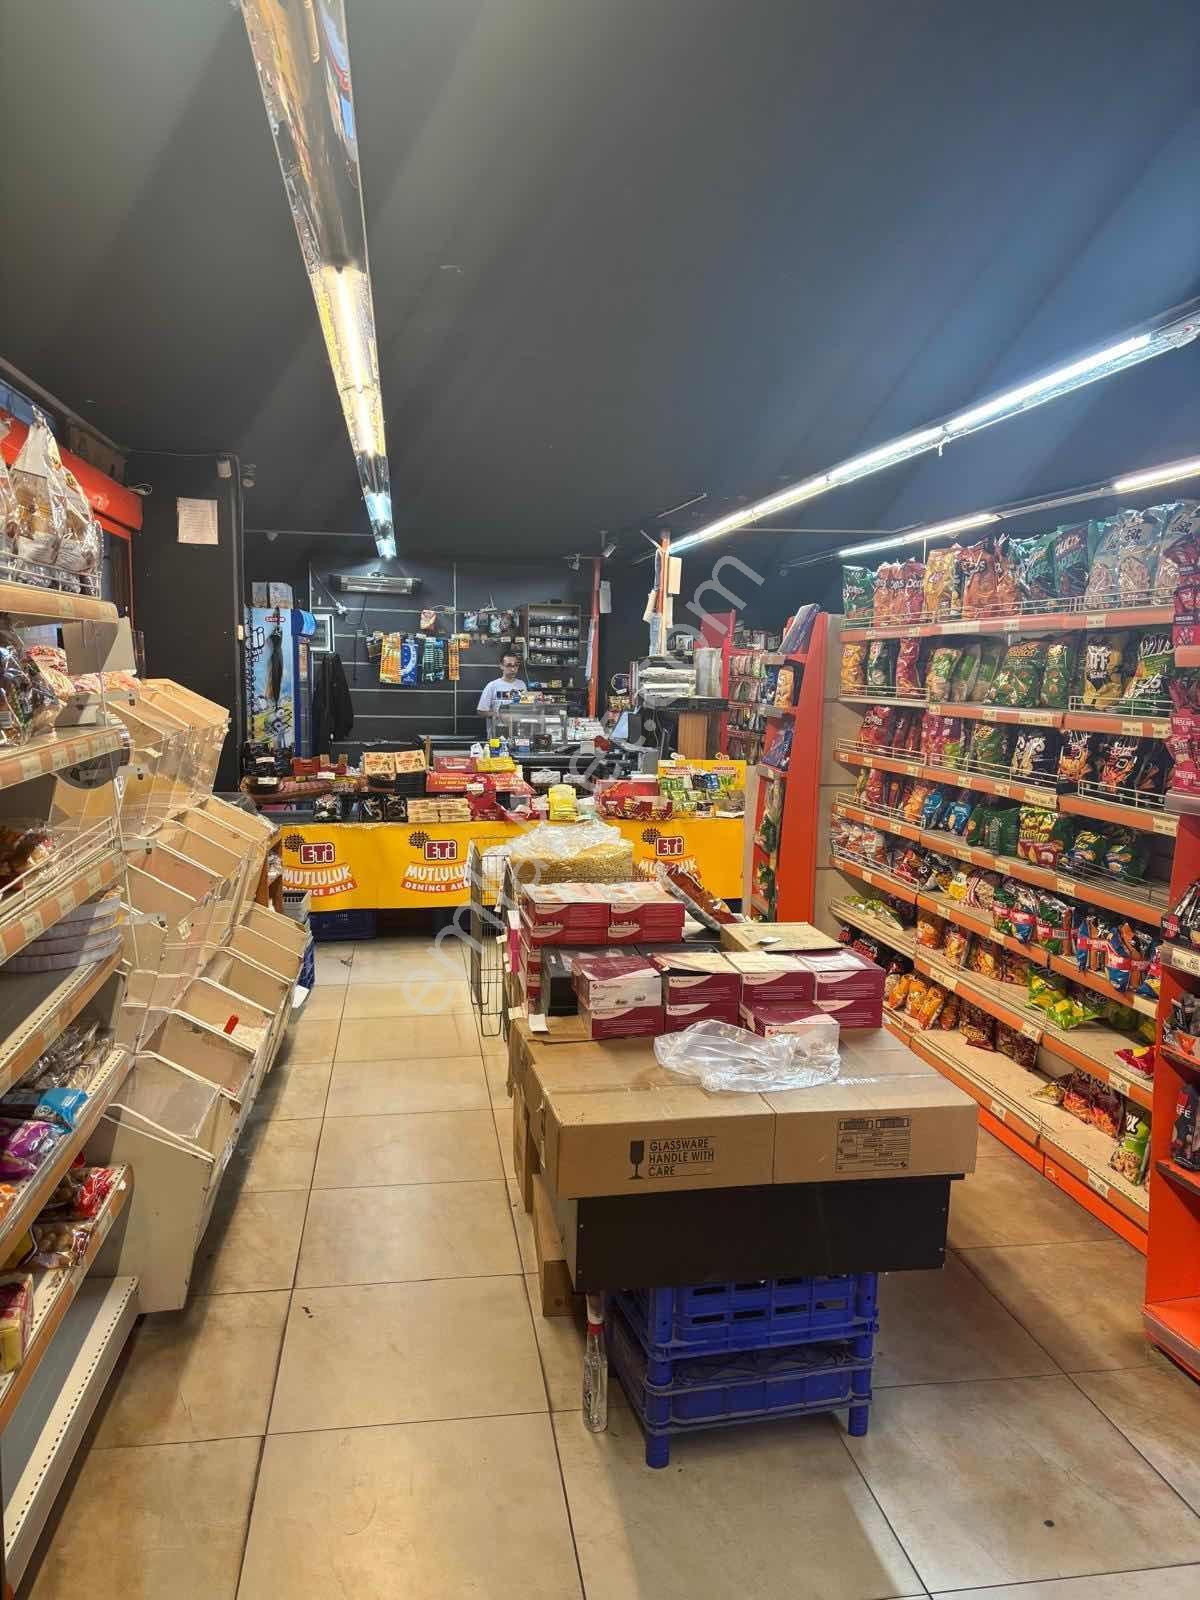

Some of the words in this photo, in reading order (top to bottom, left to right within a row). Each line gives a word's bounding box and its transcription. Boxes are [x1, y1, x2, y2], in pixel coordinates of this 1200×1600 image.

[282, 864, 353, 886] MUTLULUK
[650, 1139, 709, 1151] GLASSWARE
[649, 1152, 689, 1163] HANDLE
[692, 1151, 714, 1161] WITH
[648, 1166, 675, 1176] CARE
